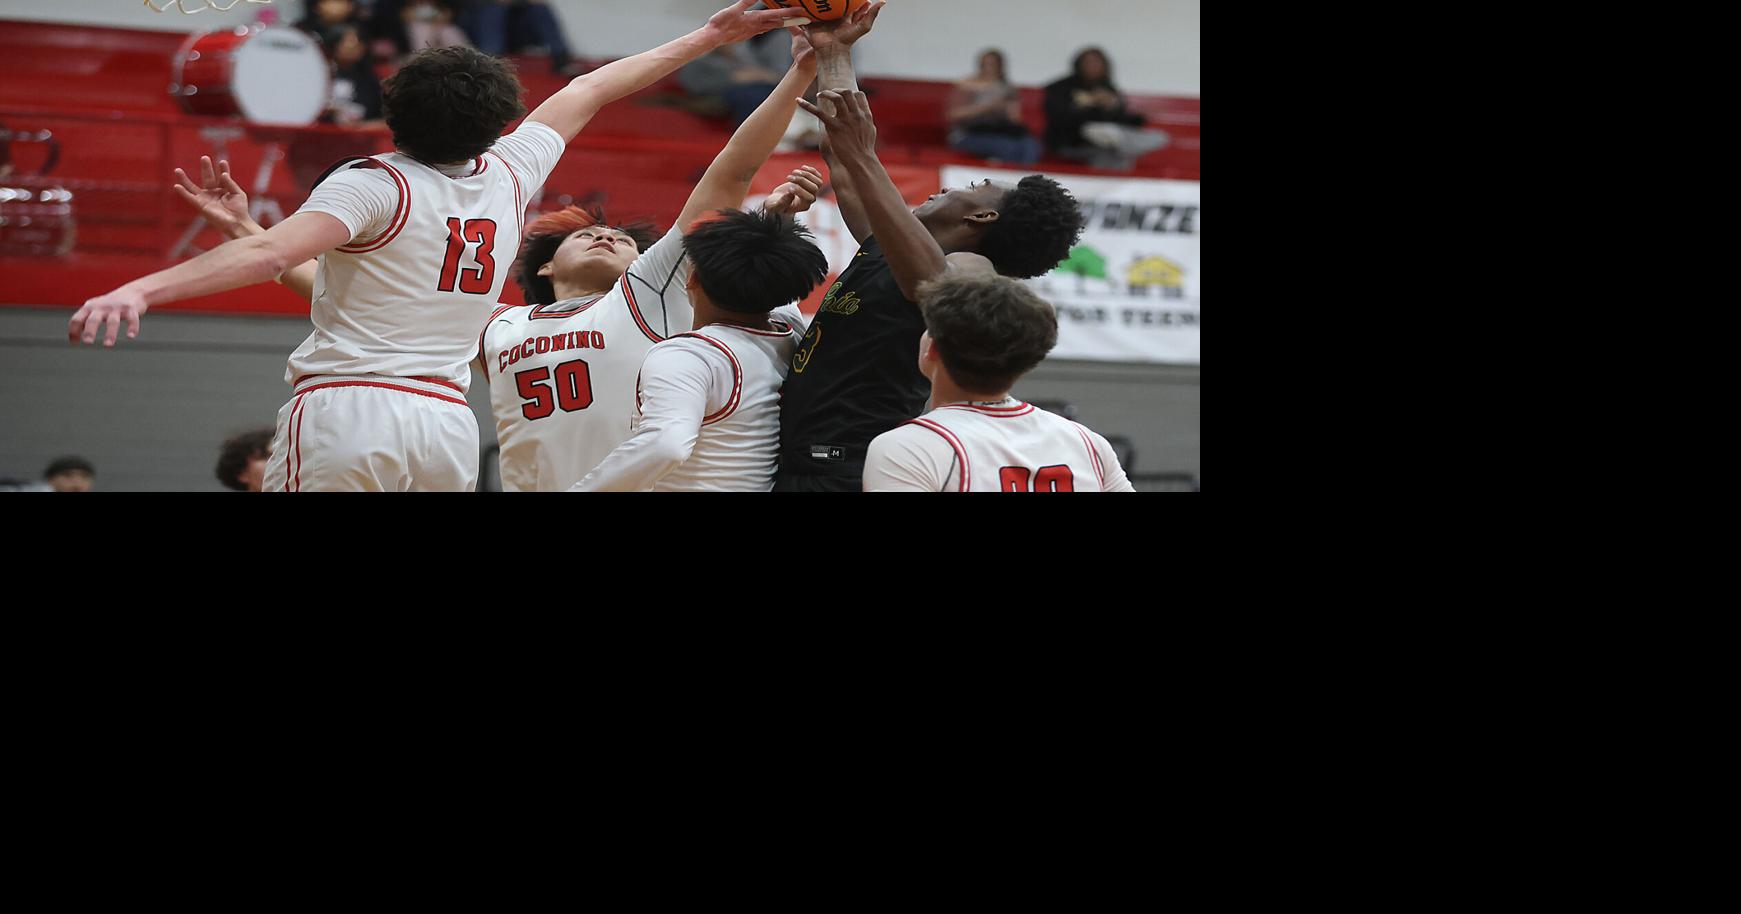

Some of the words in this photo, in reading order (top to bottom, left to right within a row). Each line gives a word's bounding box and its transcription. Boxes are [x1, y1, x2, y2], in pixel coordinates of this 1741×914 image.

[437, 216, 497, 295] 13
[498, 330, 606, 374] COCONINO
[514, 358, 594, 421] 50
